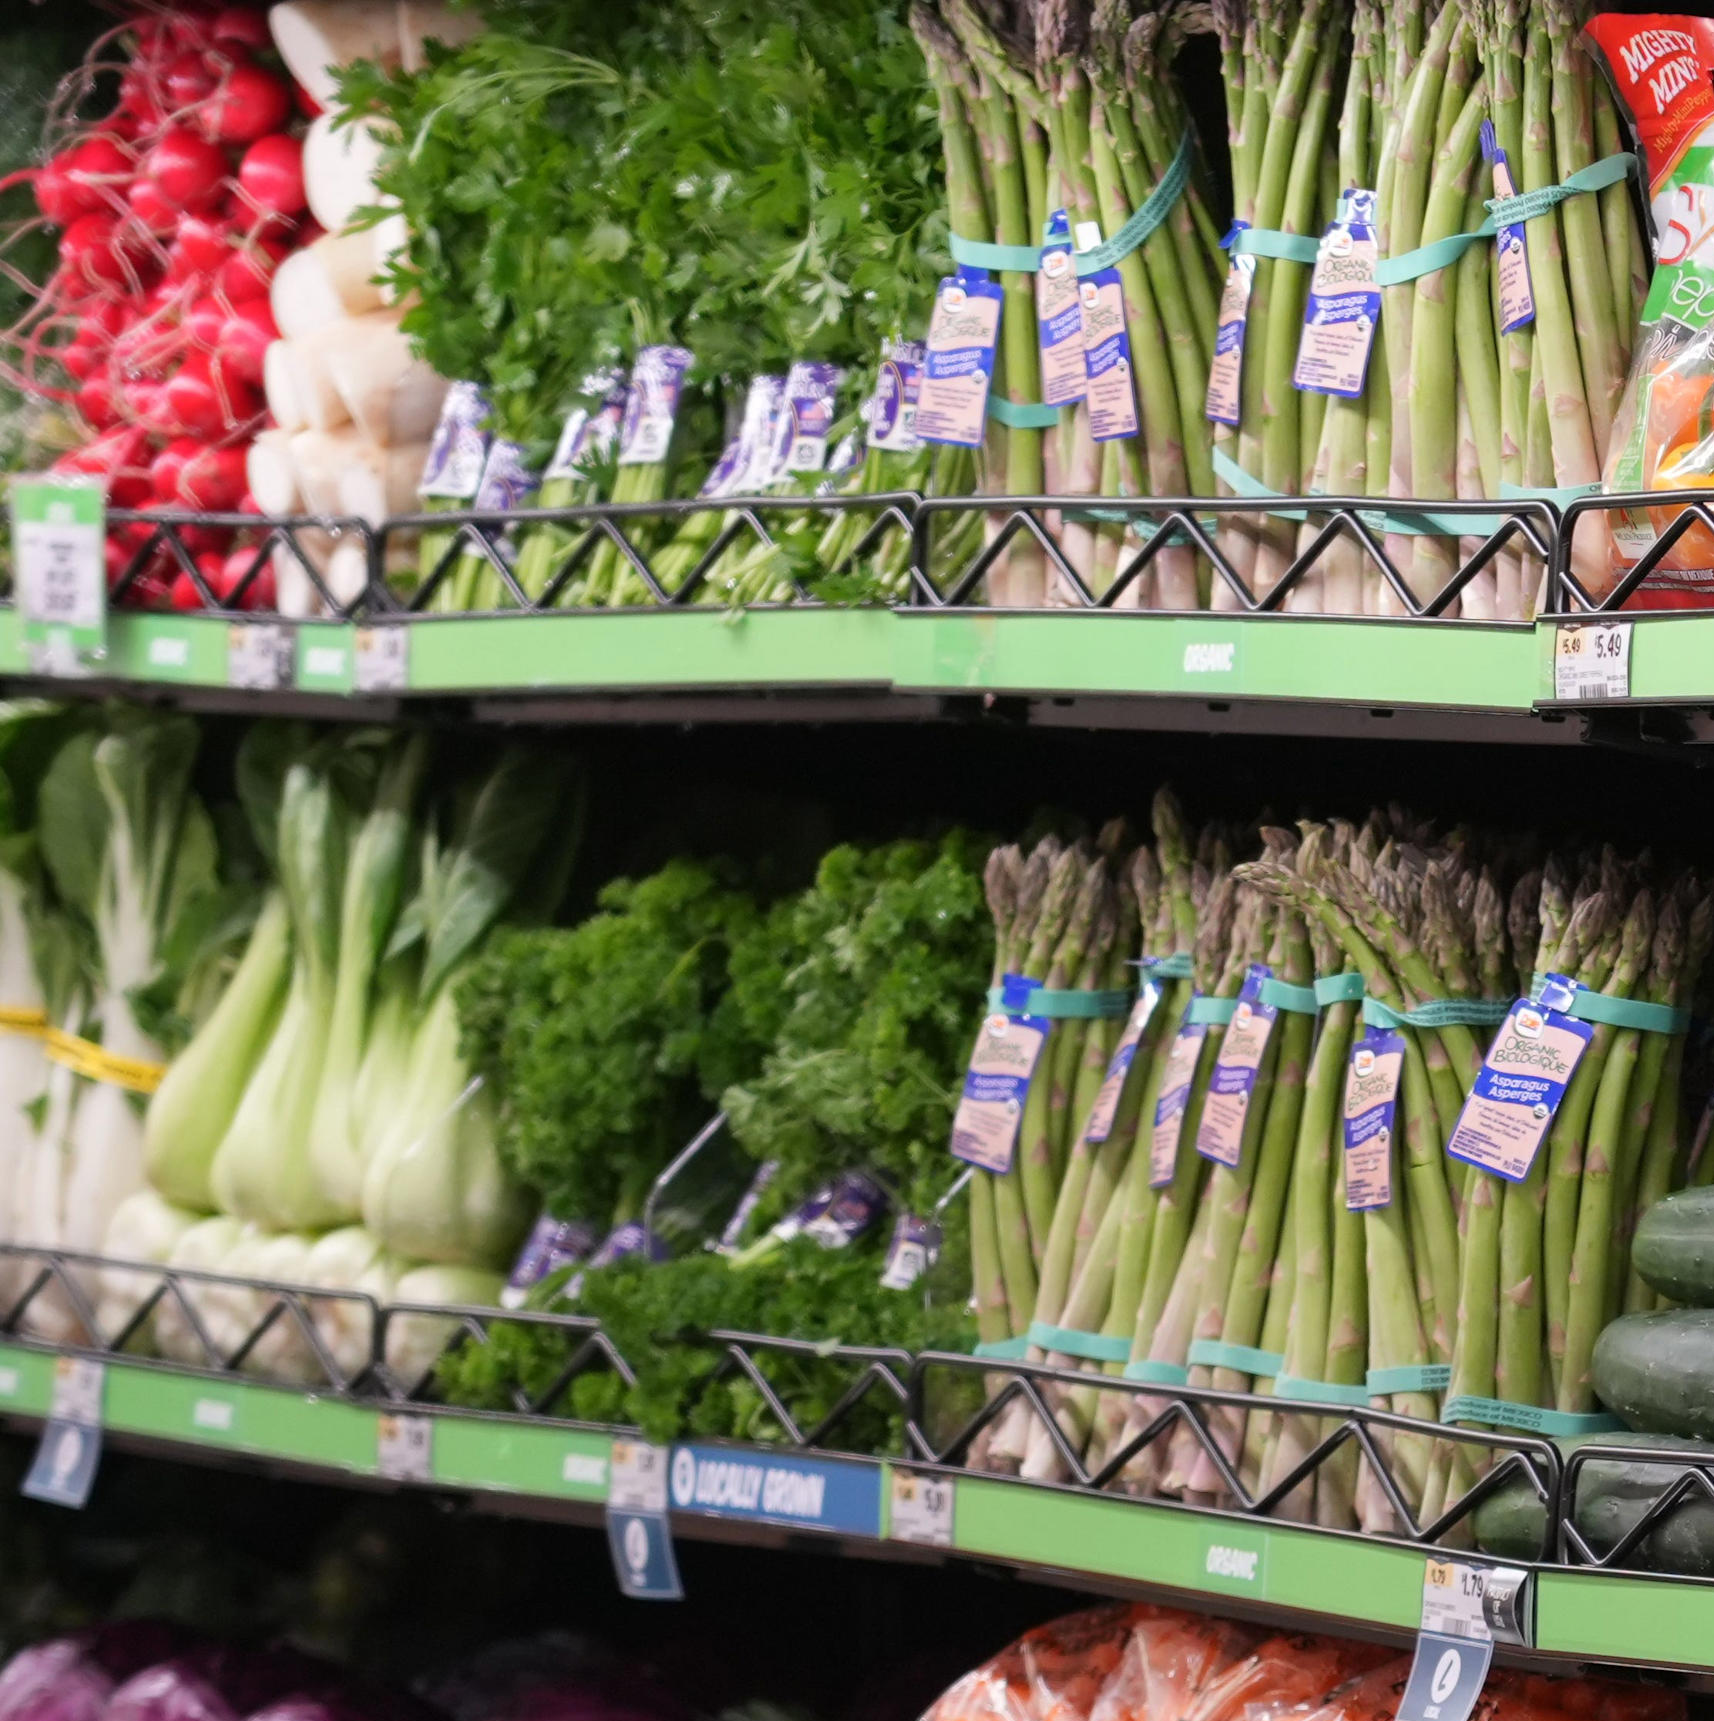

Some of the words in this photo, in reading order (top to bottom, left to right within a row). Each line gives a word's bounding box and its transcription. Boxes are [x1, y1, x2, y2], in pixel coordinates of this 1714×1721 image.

[1619, 29, 1697, 84] MIGHTY
[1504, 1036, 1561, 1060] ORGANIC
[1493, 1049, 1570, 1075] BIOLOGIQUE
[1488, 1073, 1551, 1093] Asparagus
[1487, 1086, 1543, 1102] Asperges
[1501, 1405, 1544, 1421] MEXICO
[1501, 1413, 1542, 1429] MEXICO
